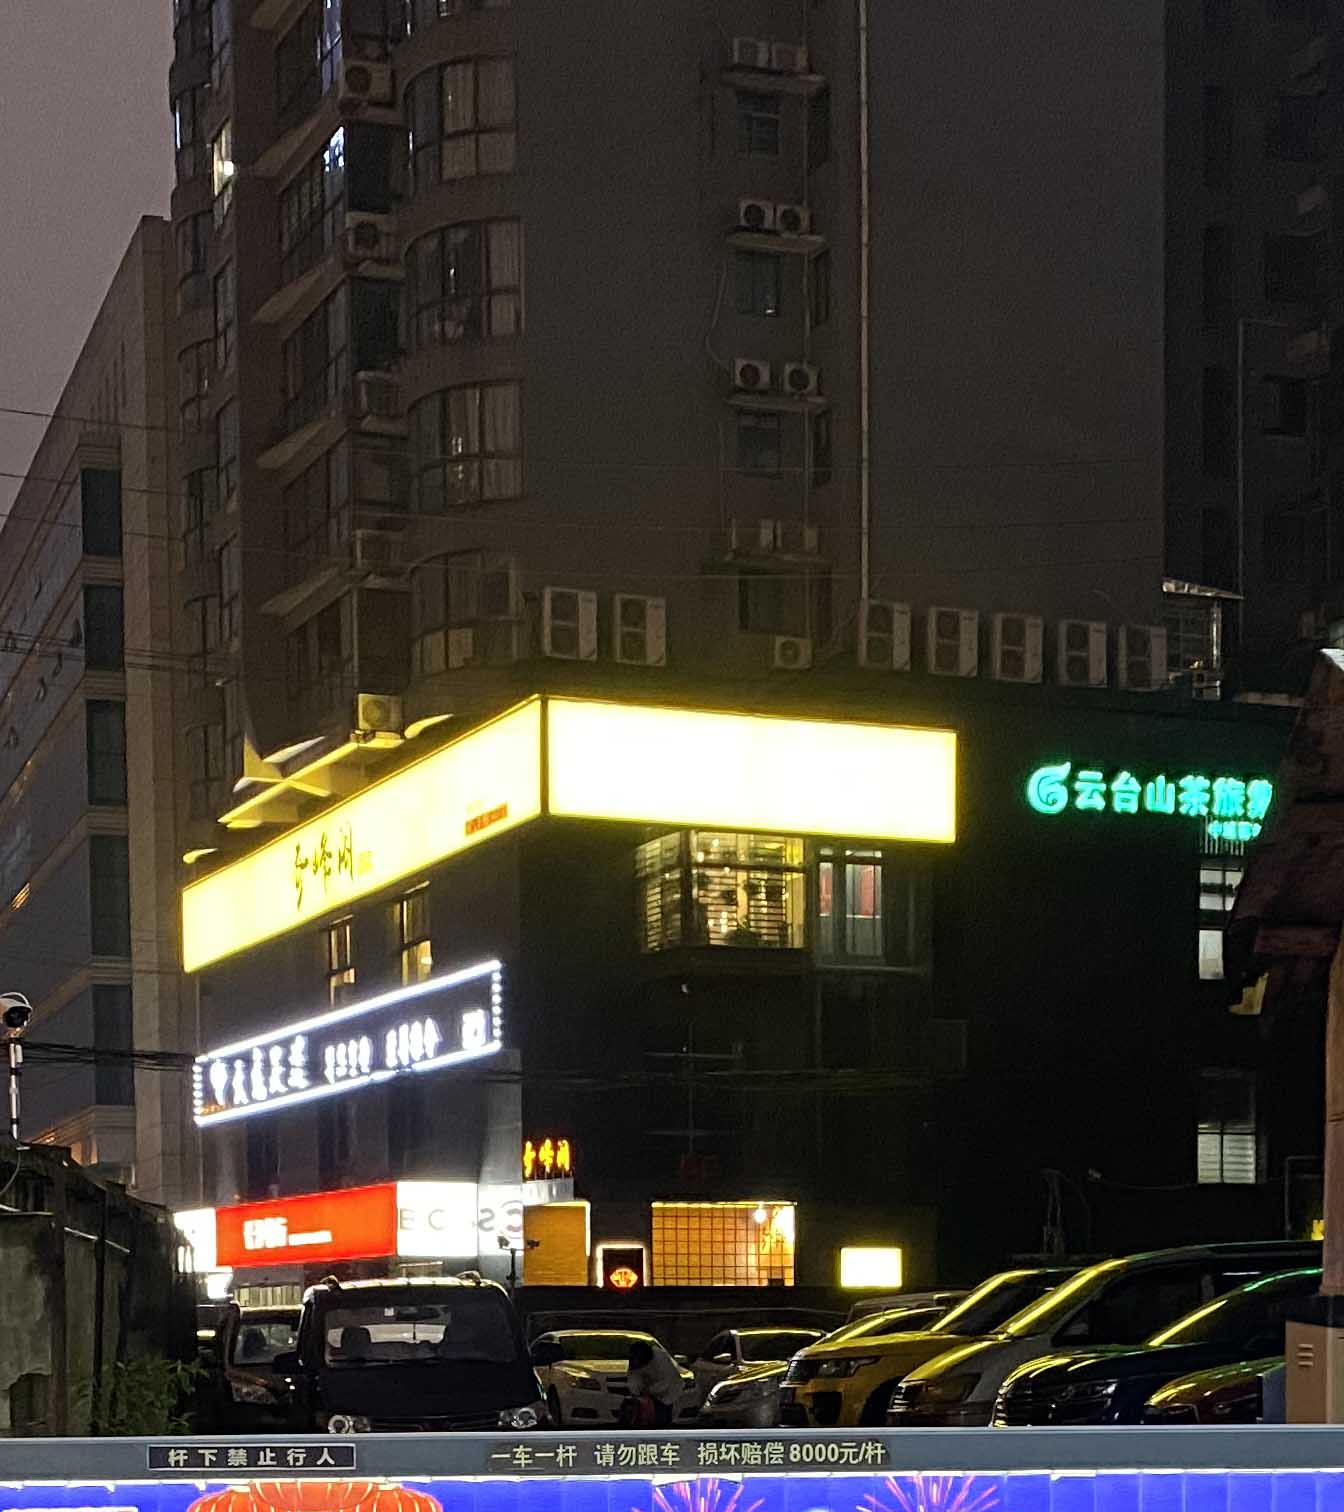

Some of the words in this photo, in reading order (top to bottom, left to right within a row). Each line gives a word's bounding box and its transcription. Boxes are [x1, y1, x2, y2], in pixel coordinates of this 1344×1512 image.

[167, 1448, 337, 1467] 杆下禁止行人
[491, 1445, 578, 1468] 一车一杆
[594, 1443, 681, 1467] 请勿跟车
